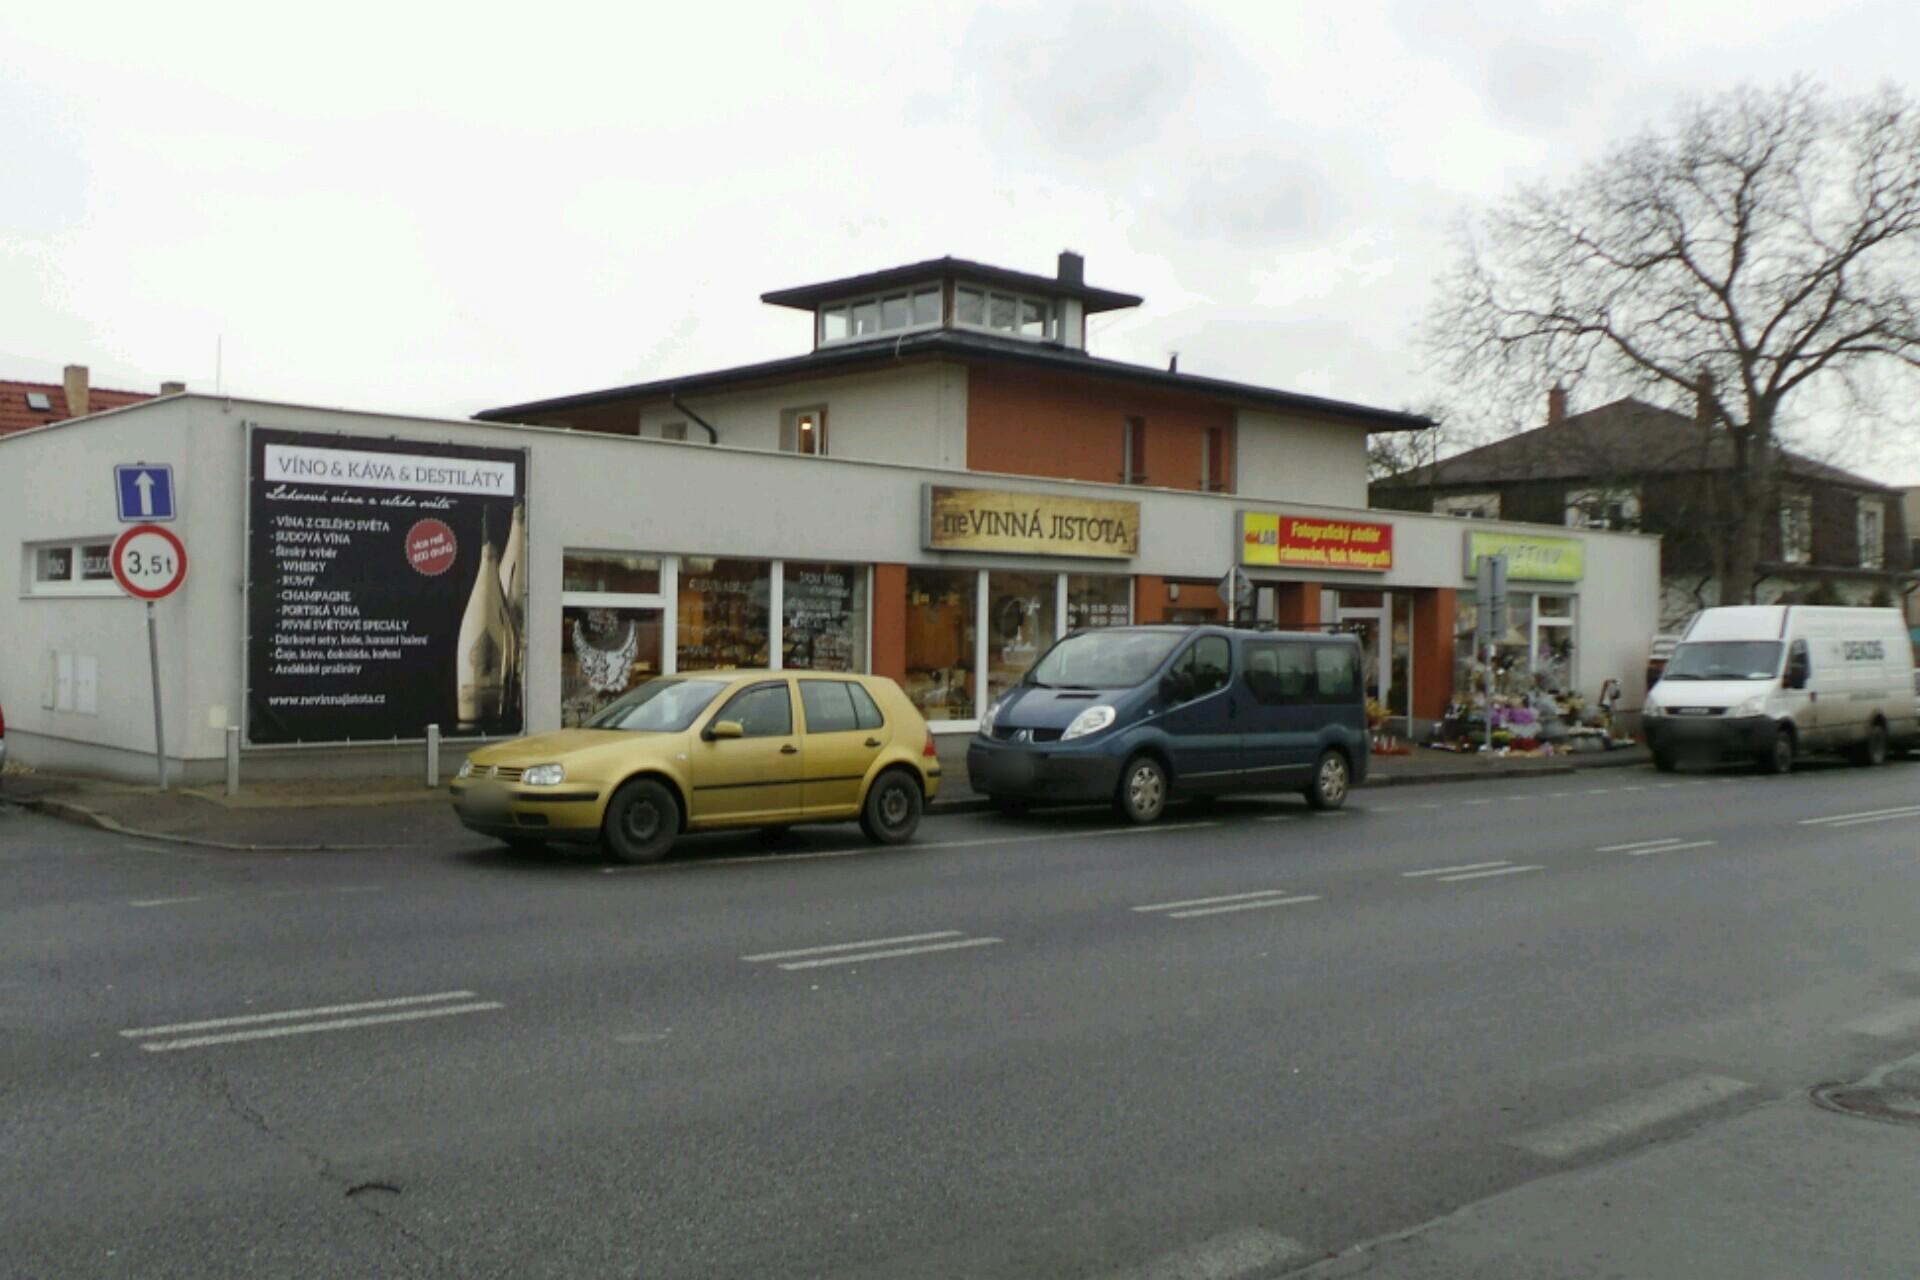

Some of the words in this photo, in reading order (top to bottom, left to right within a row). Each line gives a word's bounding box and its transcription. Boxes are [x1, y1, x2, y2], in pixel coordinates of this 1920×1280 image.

[279, 457, 328, 476] VÍNO
[331, 462, 343, 476] &
[348, 462, 395, 481] KÁVA
[400, 467, 410, 481] &
[416, 467, 504, 488] DESTILÁTY
[276, 514, 304, 528] VÍNA
[315, 517, 355, 531] CELÉHO
[943, 508, 1043, 538] neVINNÁ
[1049, 513, 1128, 544] JISTOTA
[1291, 520, 1350, 544] Fotografický
[283, 561, 326, 573] WHISKY
